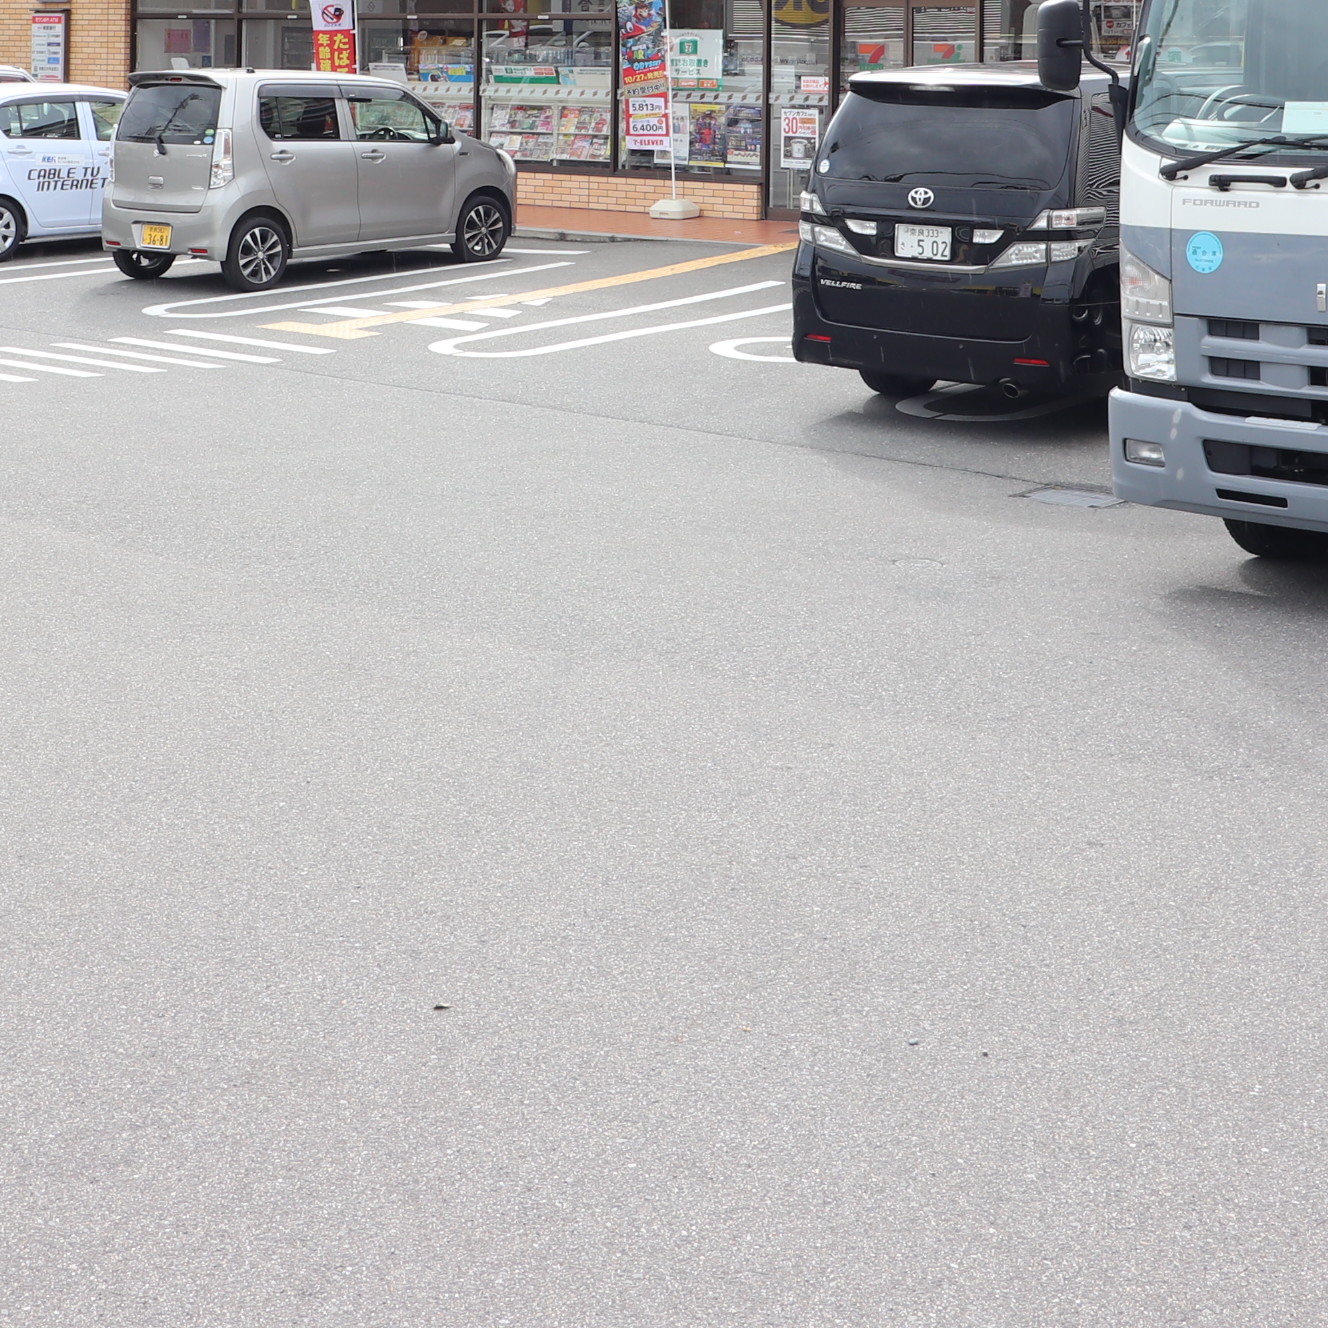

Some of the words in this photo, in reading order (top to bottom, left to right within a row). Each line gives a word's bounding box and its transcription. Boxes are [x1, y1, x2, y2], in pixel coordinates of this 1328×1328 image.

[633, 60, 663, 70] ODYSSEY
[783, 117, 798, 134] 30
[27, 167, 77, 181] CABLE
[82, 166, 101, 178] TV
[36, 177, 109, 192] INTERNET
[1182, 198, 1260, 209] FORWARD
[820, 278, 863, 290] VELLFIRE
